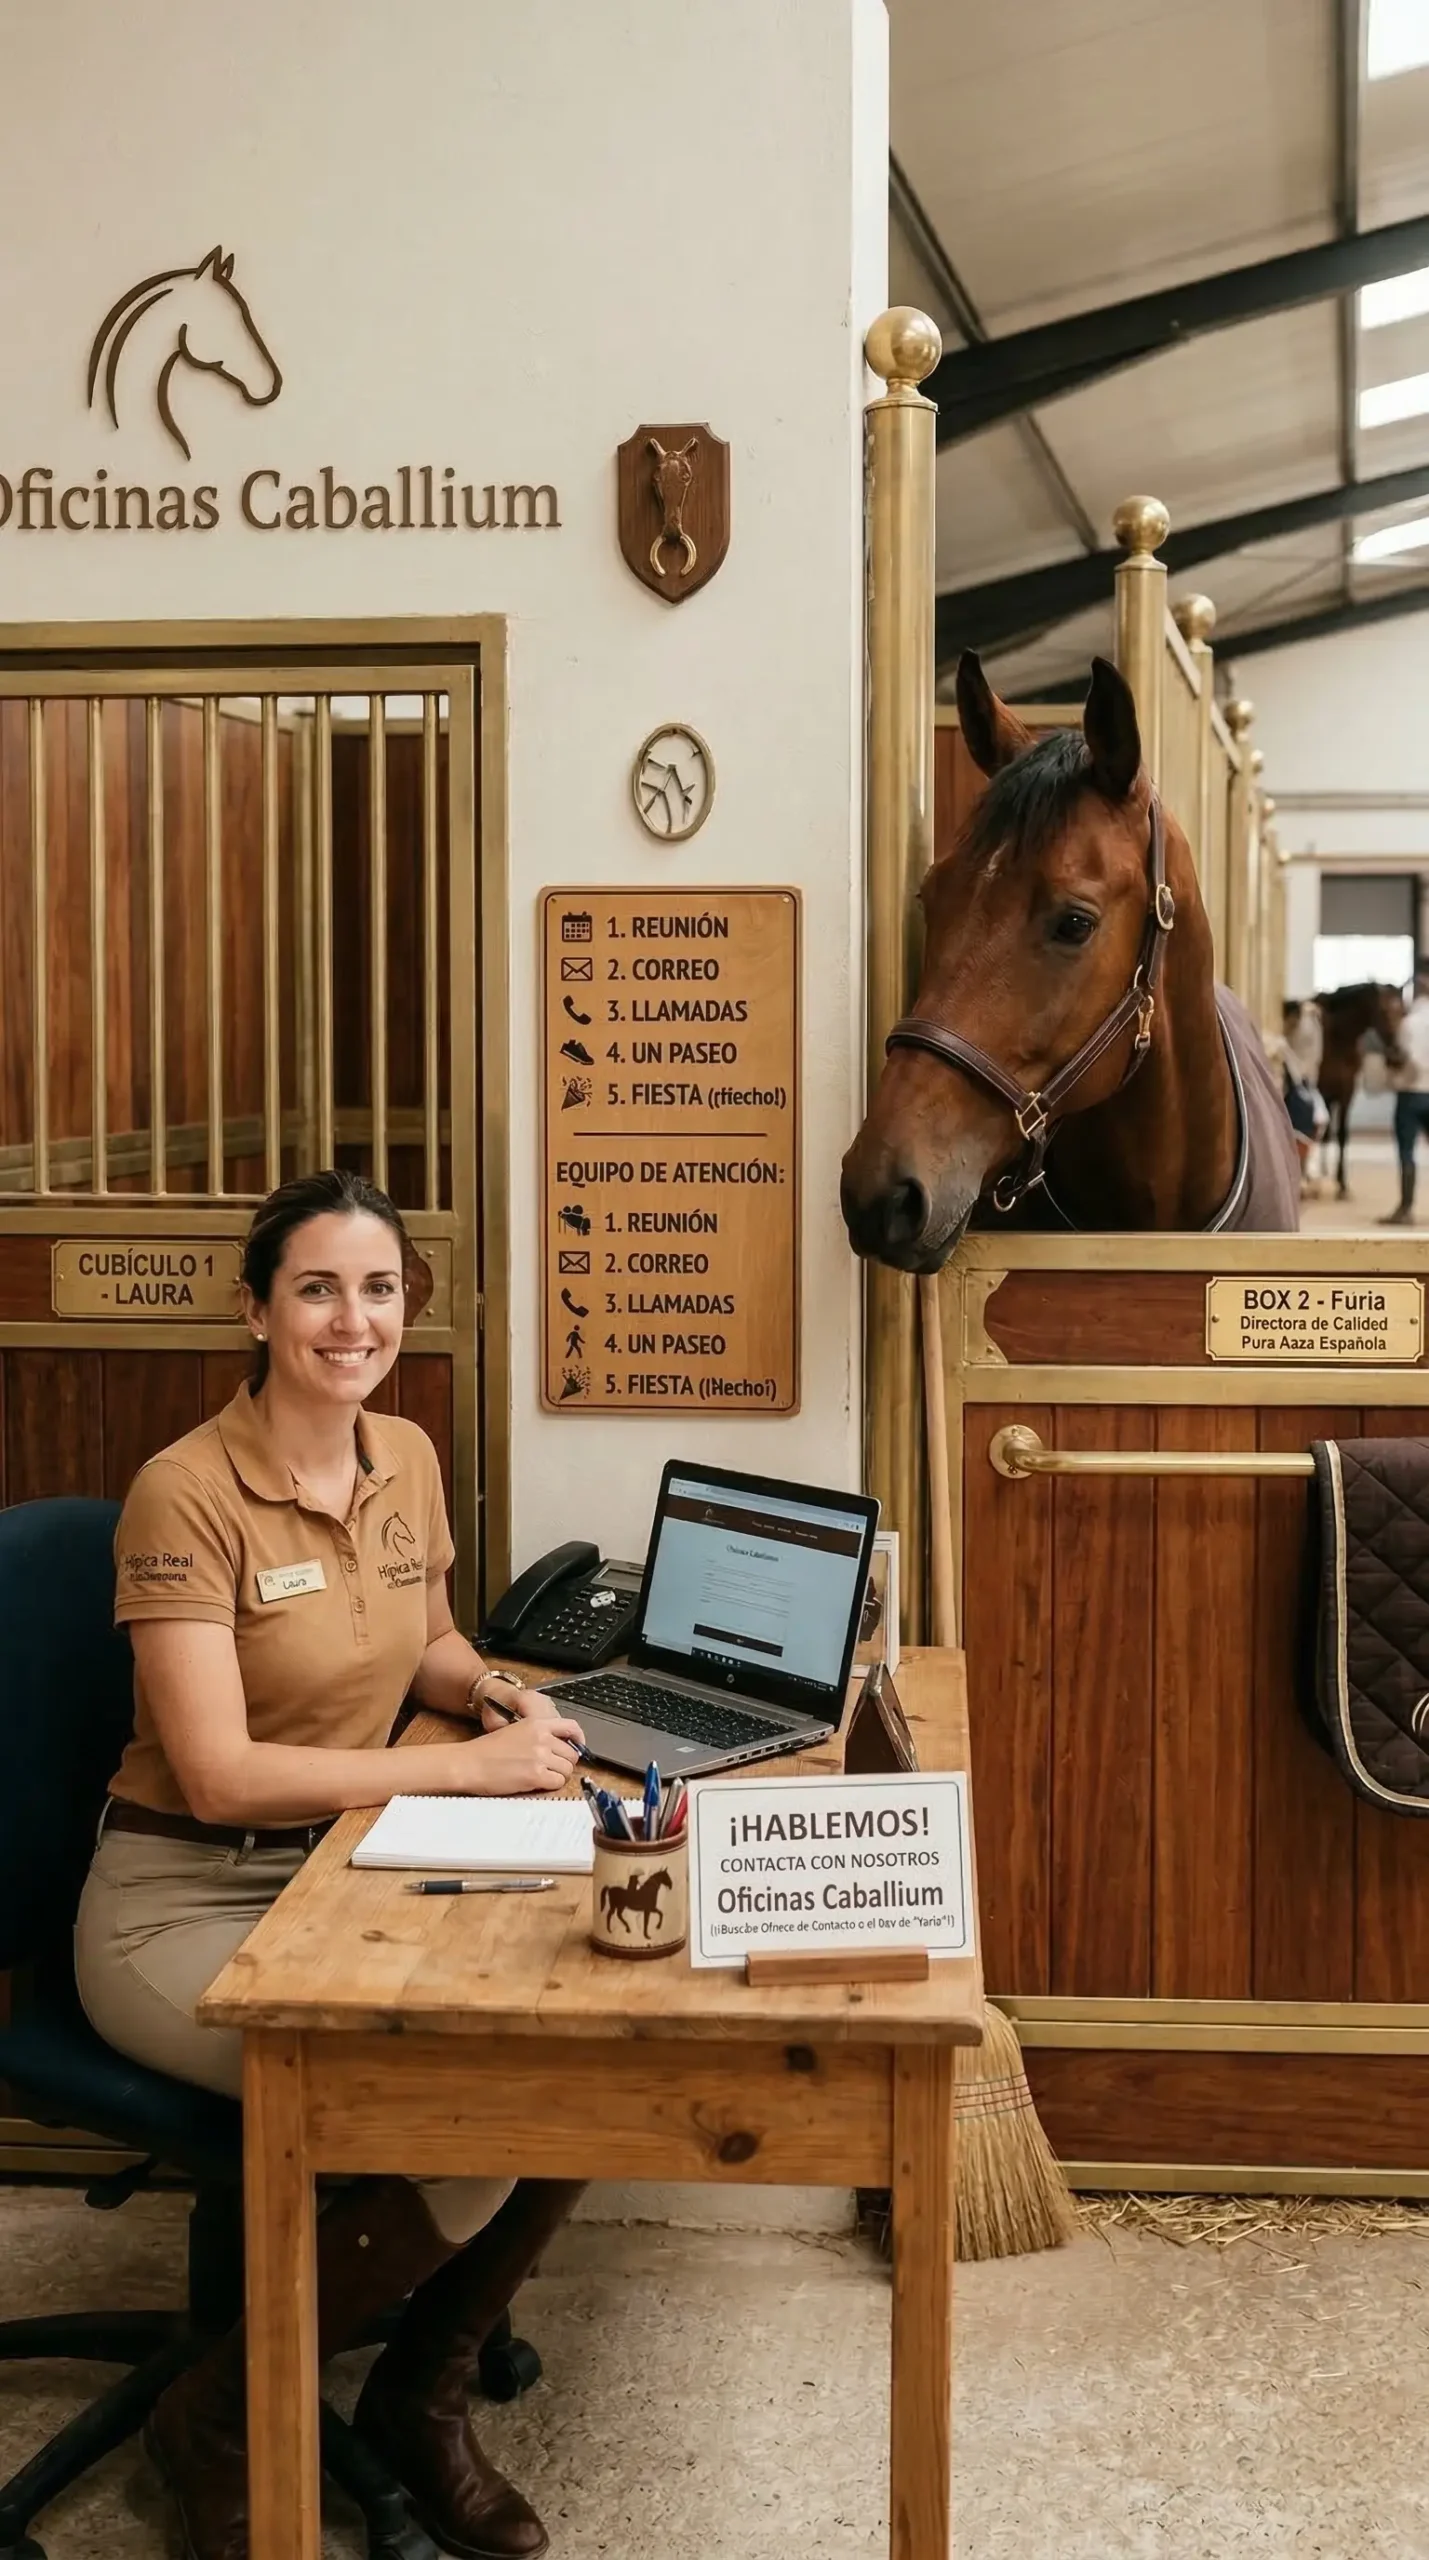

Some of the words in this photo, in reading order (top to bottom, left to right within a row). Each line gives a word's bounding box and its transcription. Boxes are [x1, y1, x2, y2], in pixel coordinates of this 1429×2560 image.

[0, 467, 220, 530] ficinas
[241, 465, 563, 530] Caballium
[606, 916, 626, 938] 1.
[632, 912, 729, 938] REUNIÓN
[607, 958, 626, 981] 2.
[632, 958, 720, 981] CORREO
[607, 1000, 626, 1022] 3.
[631, 1000, 748, 1022] LLAMADAS
[606, 1042, 626, 1064] 4.
[632, 1042, 662, 1064] UN
[669, 1042, 738, 1064] PASEO
[607, 1083, 626, 1106] 5.
[632, 1083, 703, 1106] FIESTA
[556, 1161, 634, 1188] EQUIPO
[640, 1162, 667, 1183] DE
[672, 1158, 786, 1184] ATENCIÓN:
[605, 1212, 622, 1233] 1.
[627, 1208, 718, 1234] REUNIÓN
[78, 1247, 197, 1277] CUBÍCULO
[204, 1254, 214, 1277] 1
[605, 1253, 622, 1273] 2.
[627, 1253, 709, 1274] CORREO
[115, 1283, 194, 1305] LAURA
[605, 1293, 622, 1314] 3.
[627, 1293, 735, 1315] LLAMADAS
[1243, 1289, 1291, 1311] BOX
[1298, 1290, 1310, 1311] 2
[1240, 1316, 1307, 1331] Directora
[1311, 1316, 1329, 1331] de
[1333, 1316, 1388, 1331] Calided
[604, 1333, 622, 1354] 4.
[627, 1334, 656, 1355] UN
[662, 1334, 726, 1355] PASEO
[1241, 1335, 1276, 1350] Pura
[1279, 1335, 1315, 1350] Aaza
[1319, 1335, 1387, 1354] Española
[605, 1374, 622, 1395] 5.
[627, 1374, 694, 1395] FIESTA
[162, 1552, 194, 1568] Real
[729, 1806, 929, 1847] ¡HABLEMOS!
[720, 1856, 807, 1873] CONTACTA
[810, 1854, 846, 1870] CON
[851, 1851, 940, 1869] NOSOTROS
[717, 1886, 816, 1914] Oficinas
[822, 1880, 944, 1910] Caballium
[797, 1920, 809, 1932] de
[811, 1919, 856, 1932] Contacto
[867, 1918, 876, 1929] el
[898, 1917, 911, 1928] de
